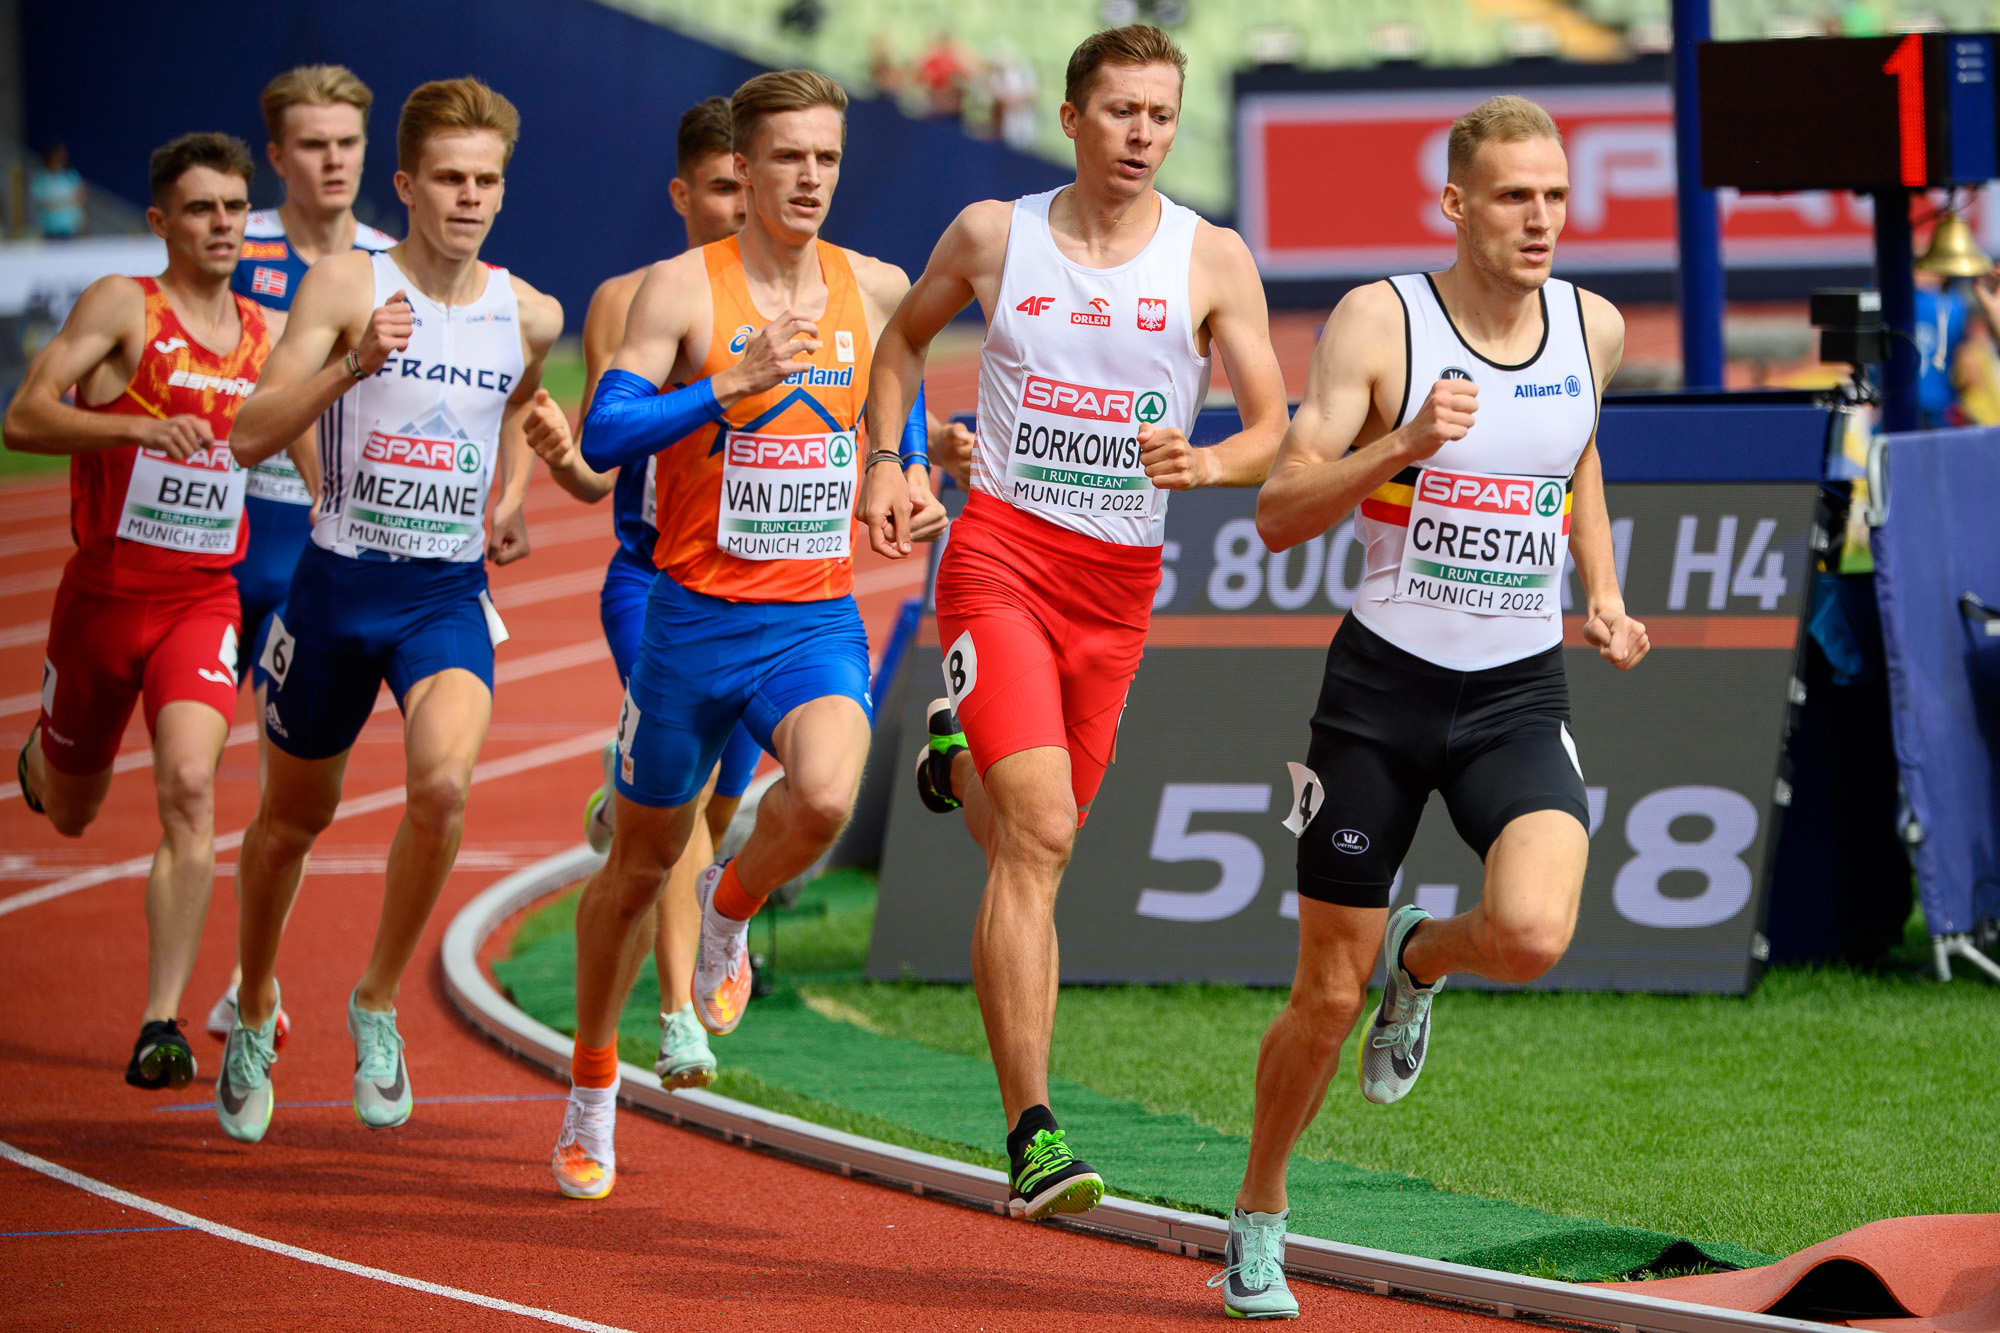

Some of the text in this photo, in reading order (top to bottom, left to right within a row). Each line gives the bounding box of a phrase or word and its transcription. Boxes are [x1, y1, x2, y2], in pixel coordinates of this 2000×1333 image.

[1881, 33, 1927, 187] 1
[1016, 295, 1056, 317] 4F
[1072, 313, 1110, 326] ORLEN
[375, 358, 513, 394] FRANCE
[778, 365, 853, 387] erland
[1514, 382, 1563, 398] Allianz
[1026, 380, 1130, 419] SPAR
[365, 434, 454, 469] SPAR
[731, 438, 825, 466] SPAR
[1015, 422, 1142, 470] BORKOWS
[157, 475, 229, 512] BEN
[352, 471, 478, 516] MEZIANE
[1042, 469, 1047, 480] I
[1049, 470, 1079, 484] RUN
[1422, 475, 1530, 511] SPAR
[726, 480, 852, 514] VAN DIEPEN
[1014, 481, 1144, 511] MUNICH 2022
[127, 518, 231, 549] MUNICH 2022
[348, 523, 421, 550] MUNICH
[382, 514, 407, 527] RUN
[753, 521, 758, 533] I
[760, 522, 785, 533] RUN
[727, 535, 842, 554] MUNICH 2022
[1412, 517, 1556, 567] CRESTAN
[1439, 565, 1446, 577] I
[1448, 567, 1478, 582] RUN
[1667, 515, 1788, 611] H4
[1408, 577, 1544, 611] MUNICH 2022
[271, 638, 287, 677] 6
[949, 649, 967, 696] 8
[1298, 781, 1314, 829] 4
[1337, 841, 1365, 851] vermarc
